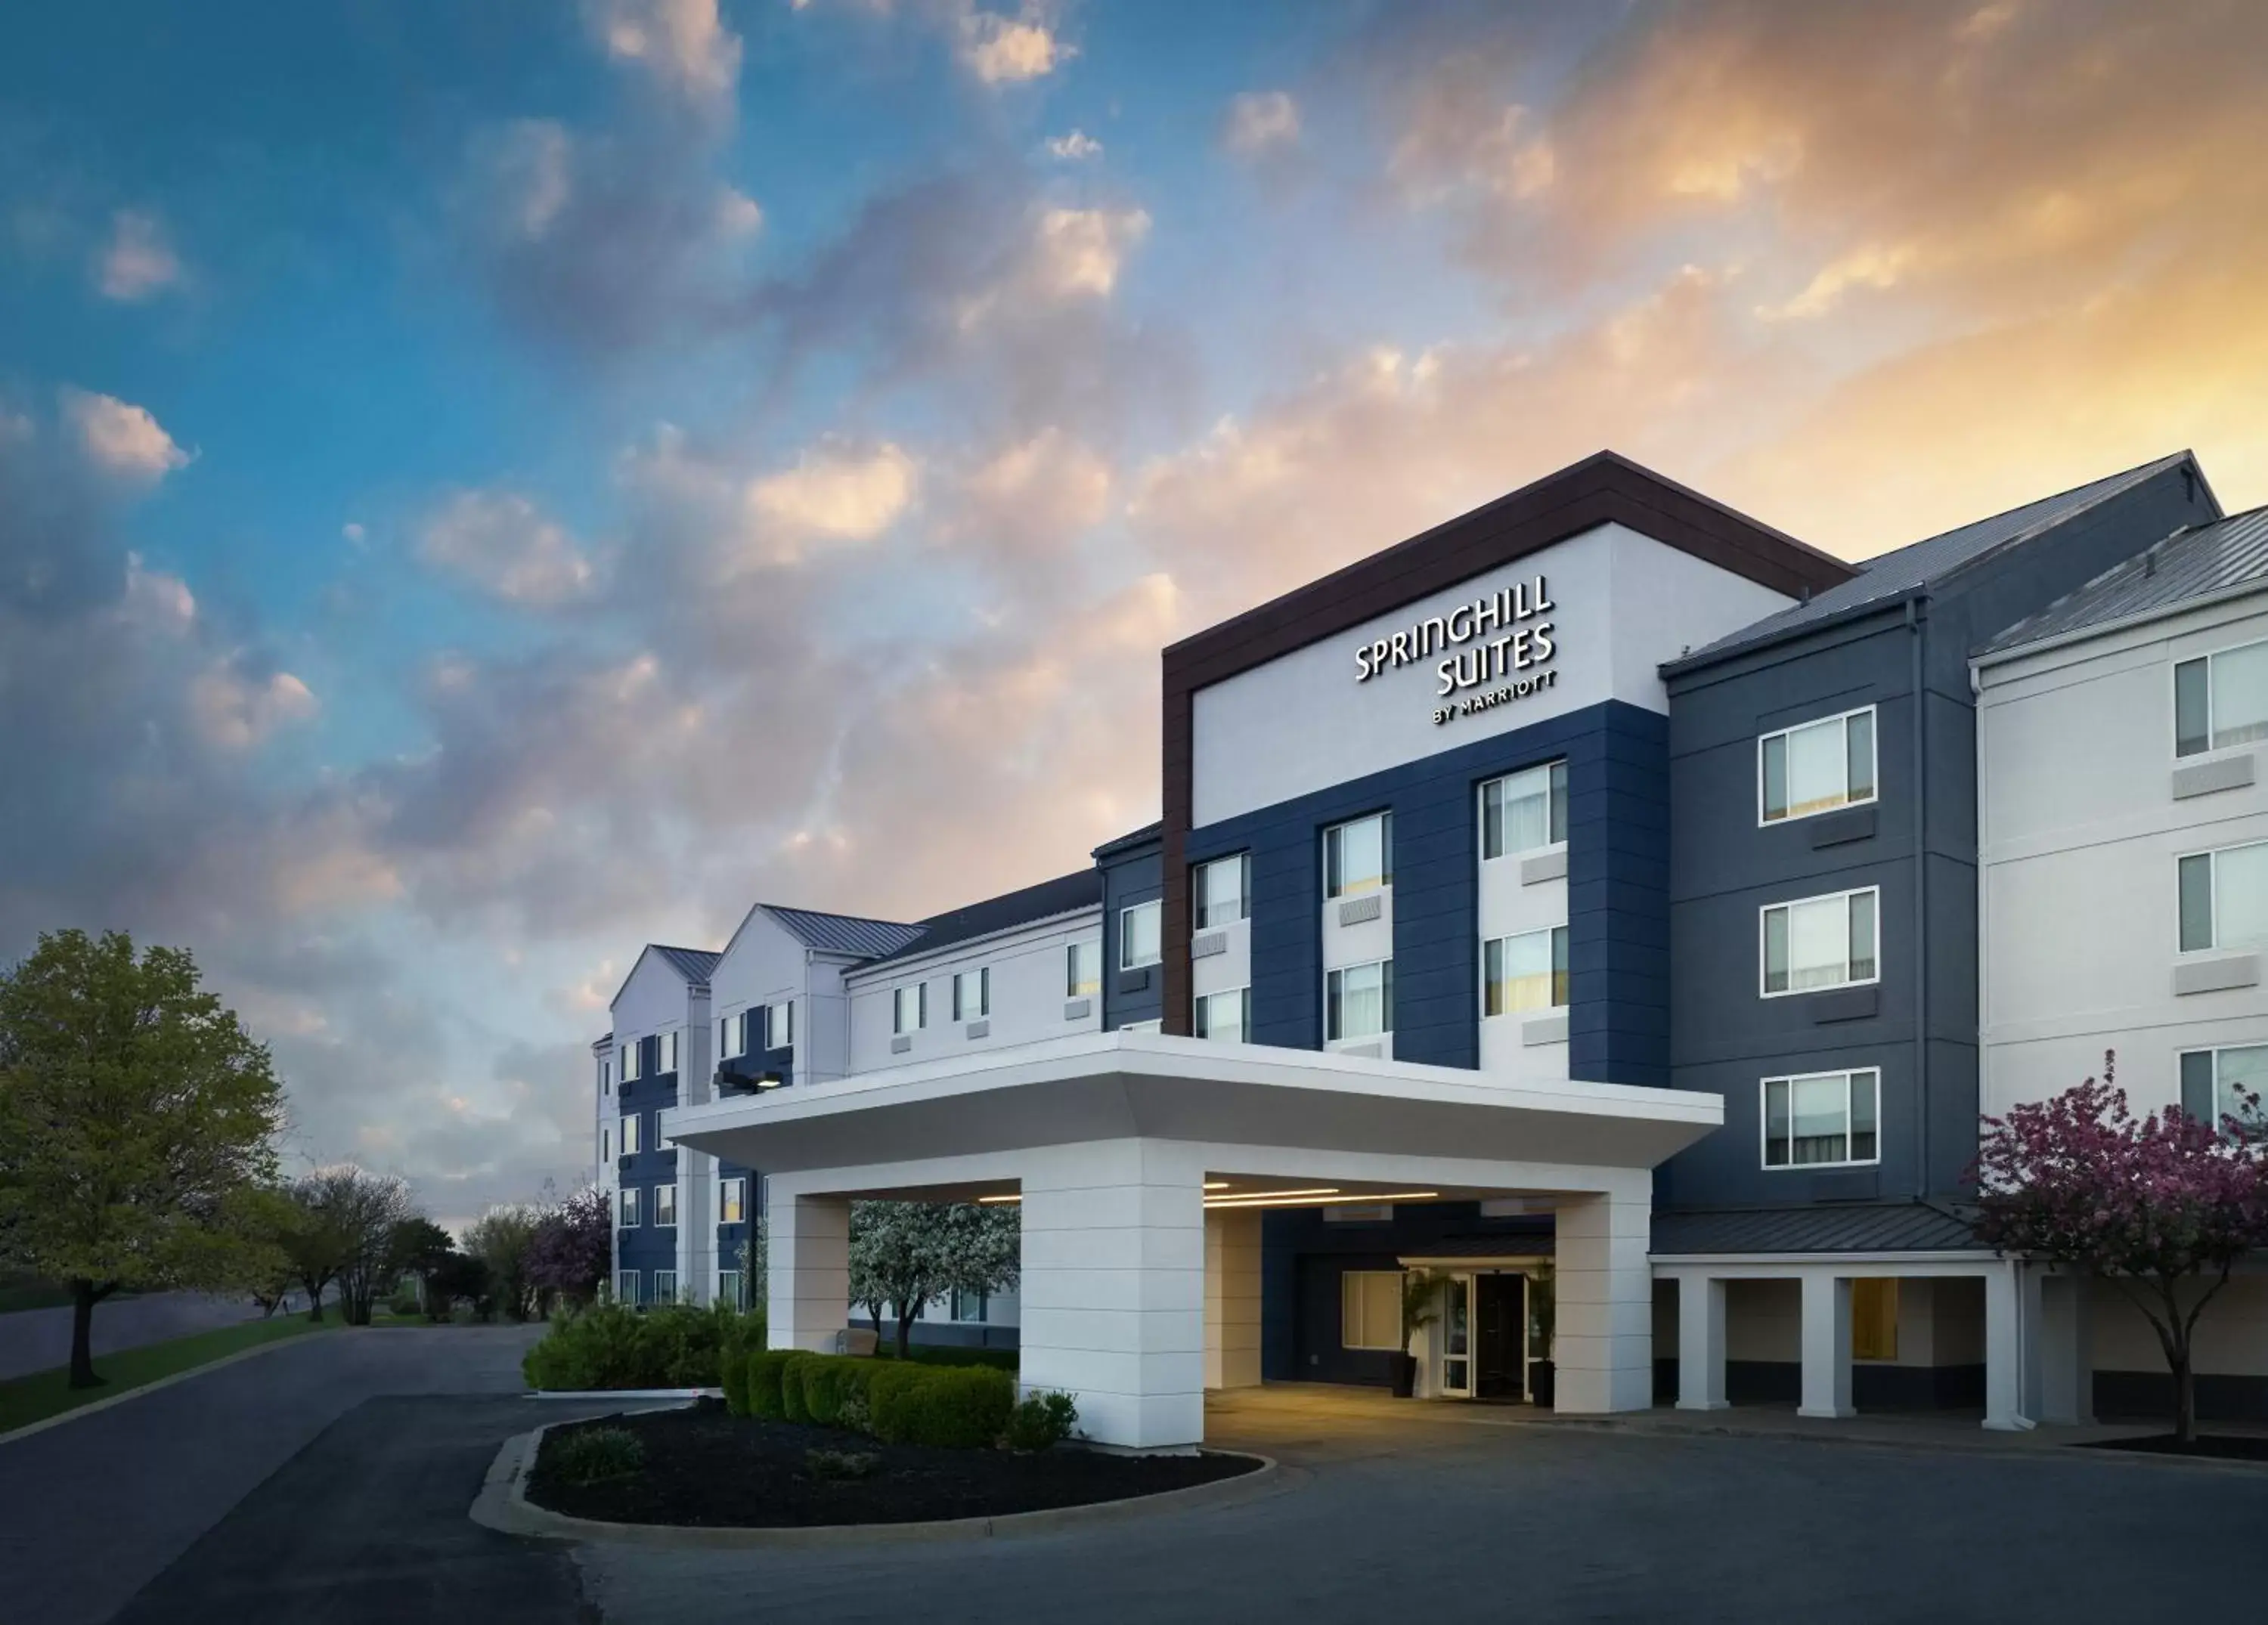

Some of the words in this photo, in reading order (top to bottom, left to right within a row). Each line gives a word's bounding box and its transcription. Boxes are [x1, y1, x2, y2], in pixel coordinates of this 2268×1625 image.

[1356, 574, 1554, 681] SPRINGHILL
[1438, 622, 1554, 695] SUITES
[1433, 704, 1455, 723] BY
[1461, 670, 1557, 715] MARRIOTT
